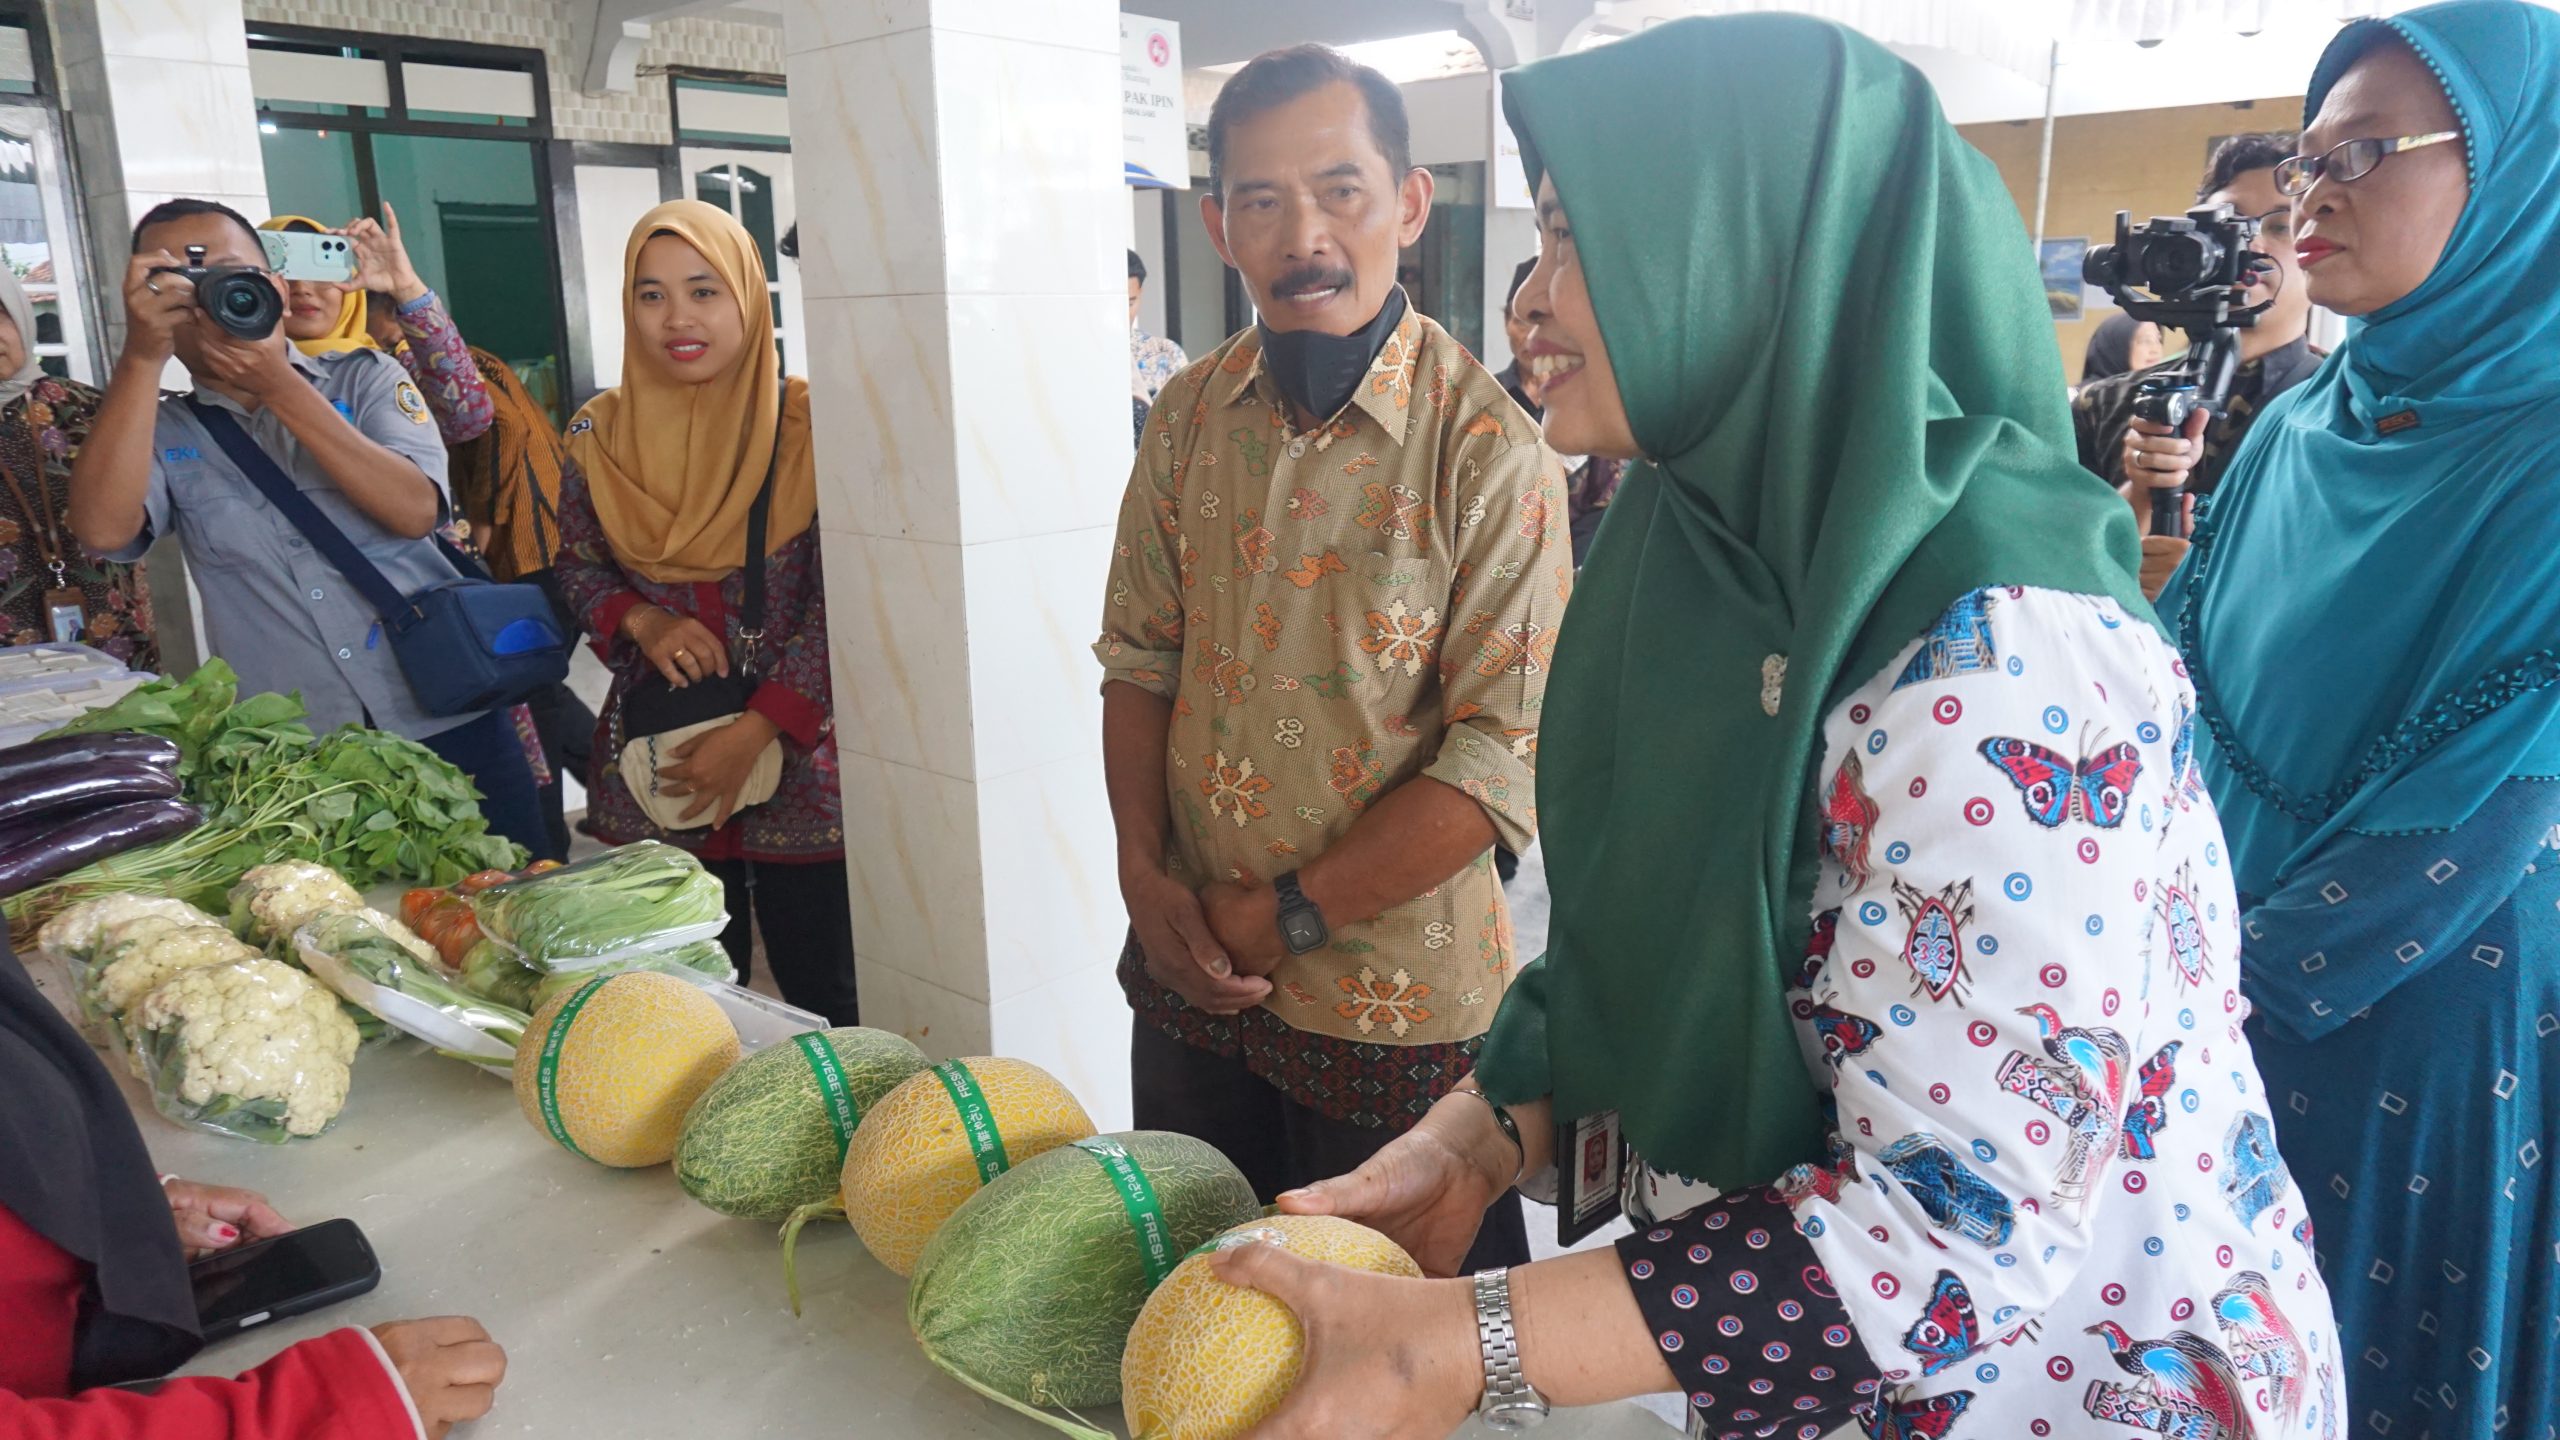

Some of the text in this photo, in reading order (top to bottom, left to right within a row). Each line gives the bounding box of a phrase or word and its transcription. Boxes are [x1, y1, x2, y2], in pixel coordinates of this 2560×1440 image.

[1124, 90, 1175, 109] PAK IPIN
[804, 1034, 856, 1140] FRESH VEGETABLES
[949, 1070, 973, 1098] FRESH
[1140, 1212, 1167, 1266] FRESH
